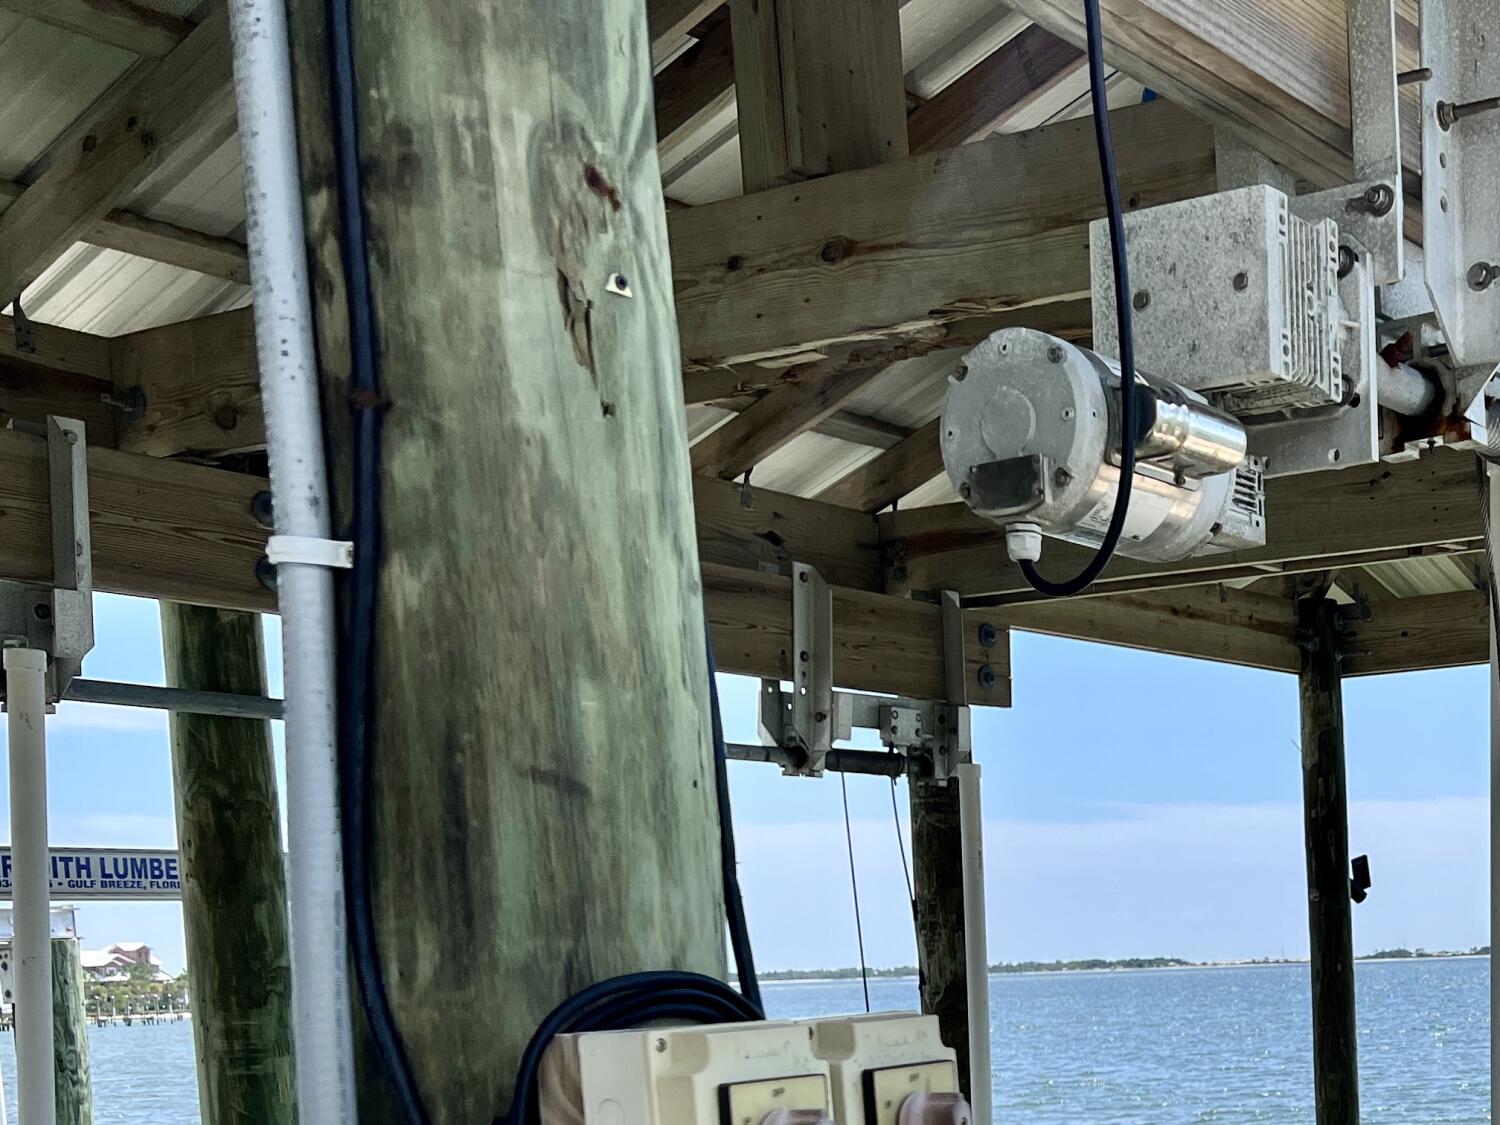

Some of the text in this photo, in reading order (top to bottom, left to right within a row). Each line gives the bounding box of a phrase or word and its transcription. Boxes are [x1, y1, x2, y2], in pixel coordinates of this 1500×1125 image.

[100, 857, 178, 880] LUMBE
[68, 880, 97, 888] GULF
[101, 880, 147, 890] BREEZE,
